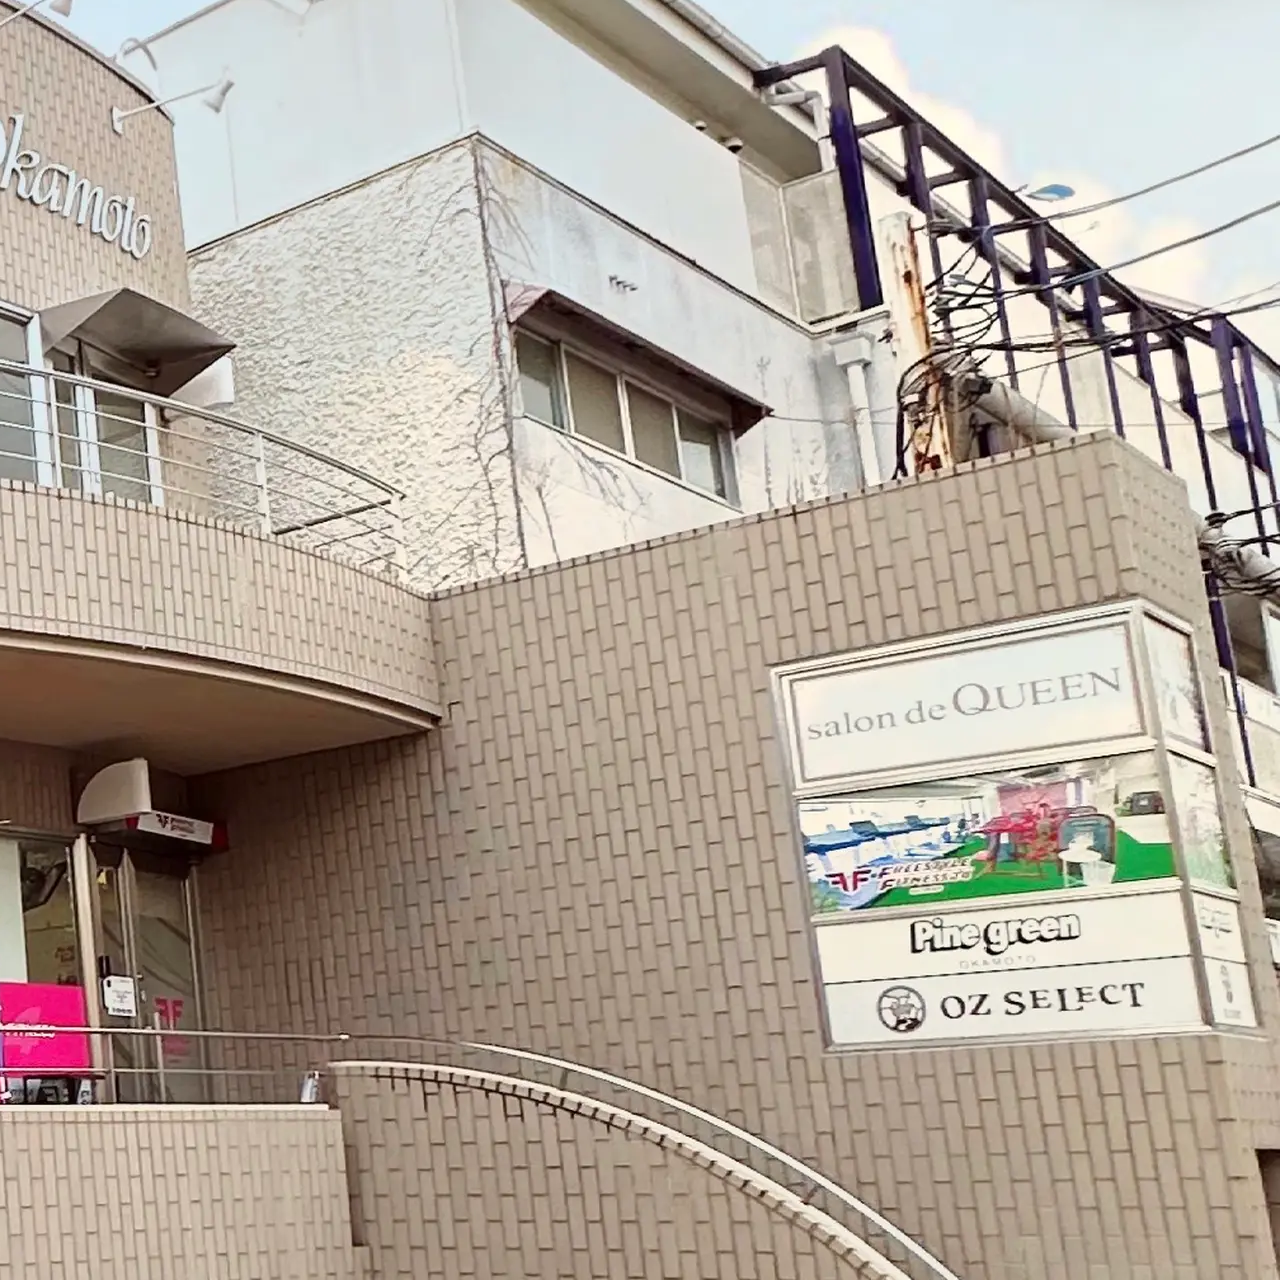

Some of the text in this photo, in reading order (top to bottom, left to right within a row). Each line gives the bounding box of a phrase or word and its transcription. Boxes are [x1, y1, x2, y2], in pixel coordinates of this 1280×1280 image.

[807, 667, 1122, 740] salon de QUEEN
[910, 913, 1082, 956] Pine green
[959, 954, 1037, 970] OKAMOTO
[940, 982, 1146, 1020] OZ SELECT
